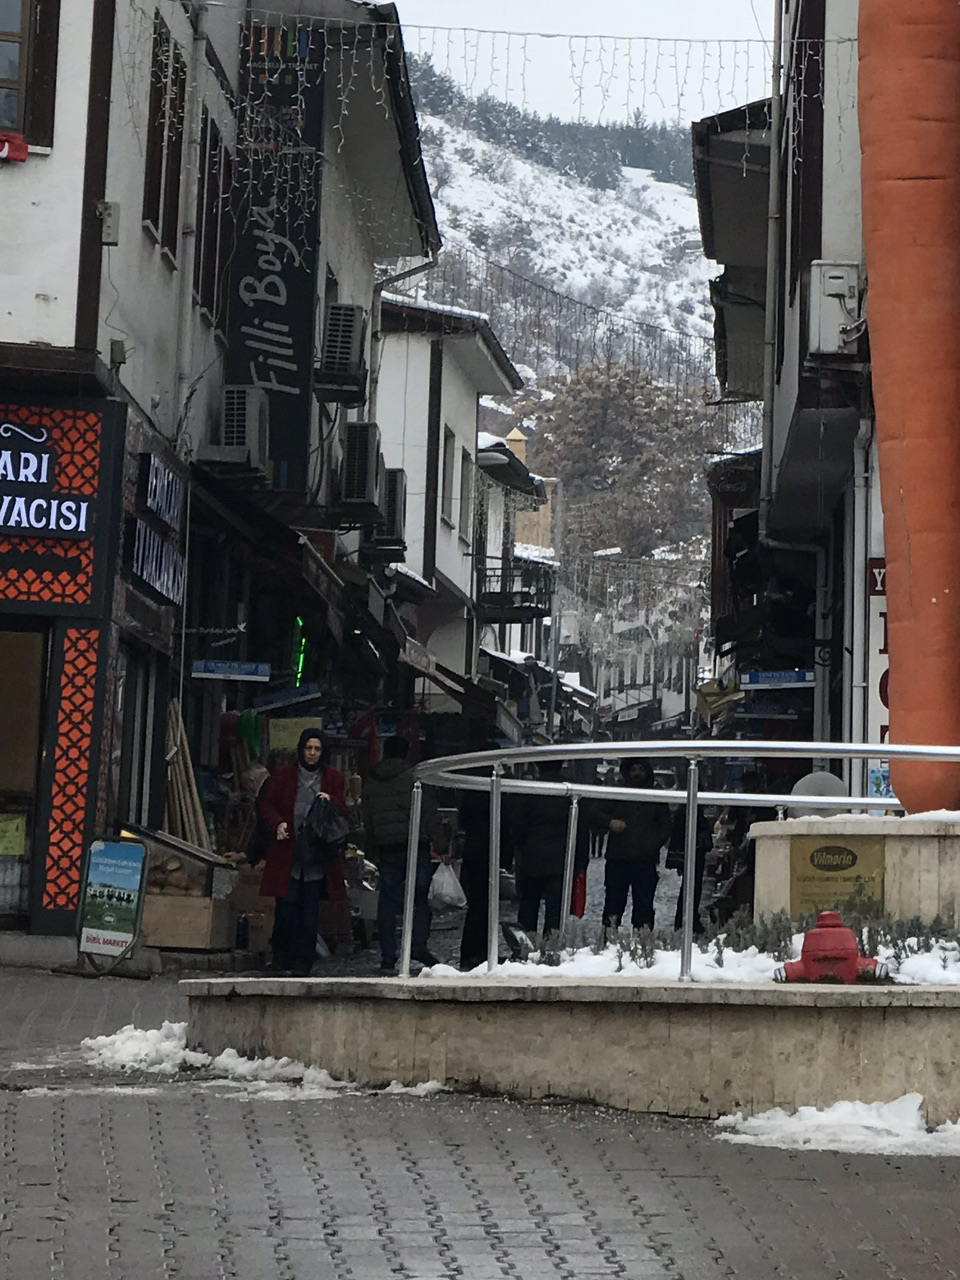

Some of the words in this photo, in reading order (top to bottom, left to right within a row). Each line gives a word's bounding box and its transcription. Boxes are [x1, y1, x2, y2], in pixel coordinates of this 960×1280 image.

[238, 195, 301, 308] Boya
[240, 316, 301, 395] Filli
[812, 851, 854, 866] Vilmorin
